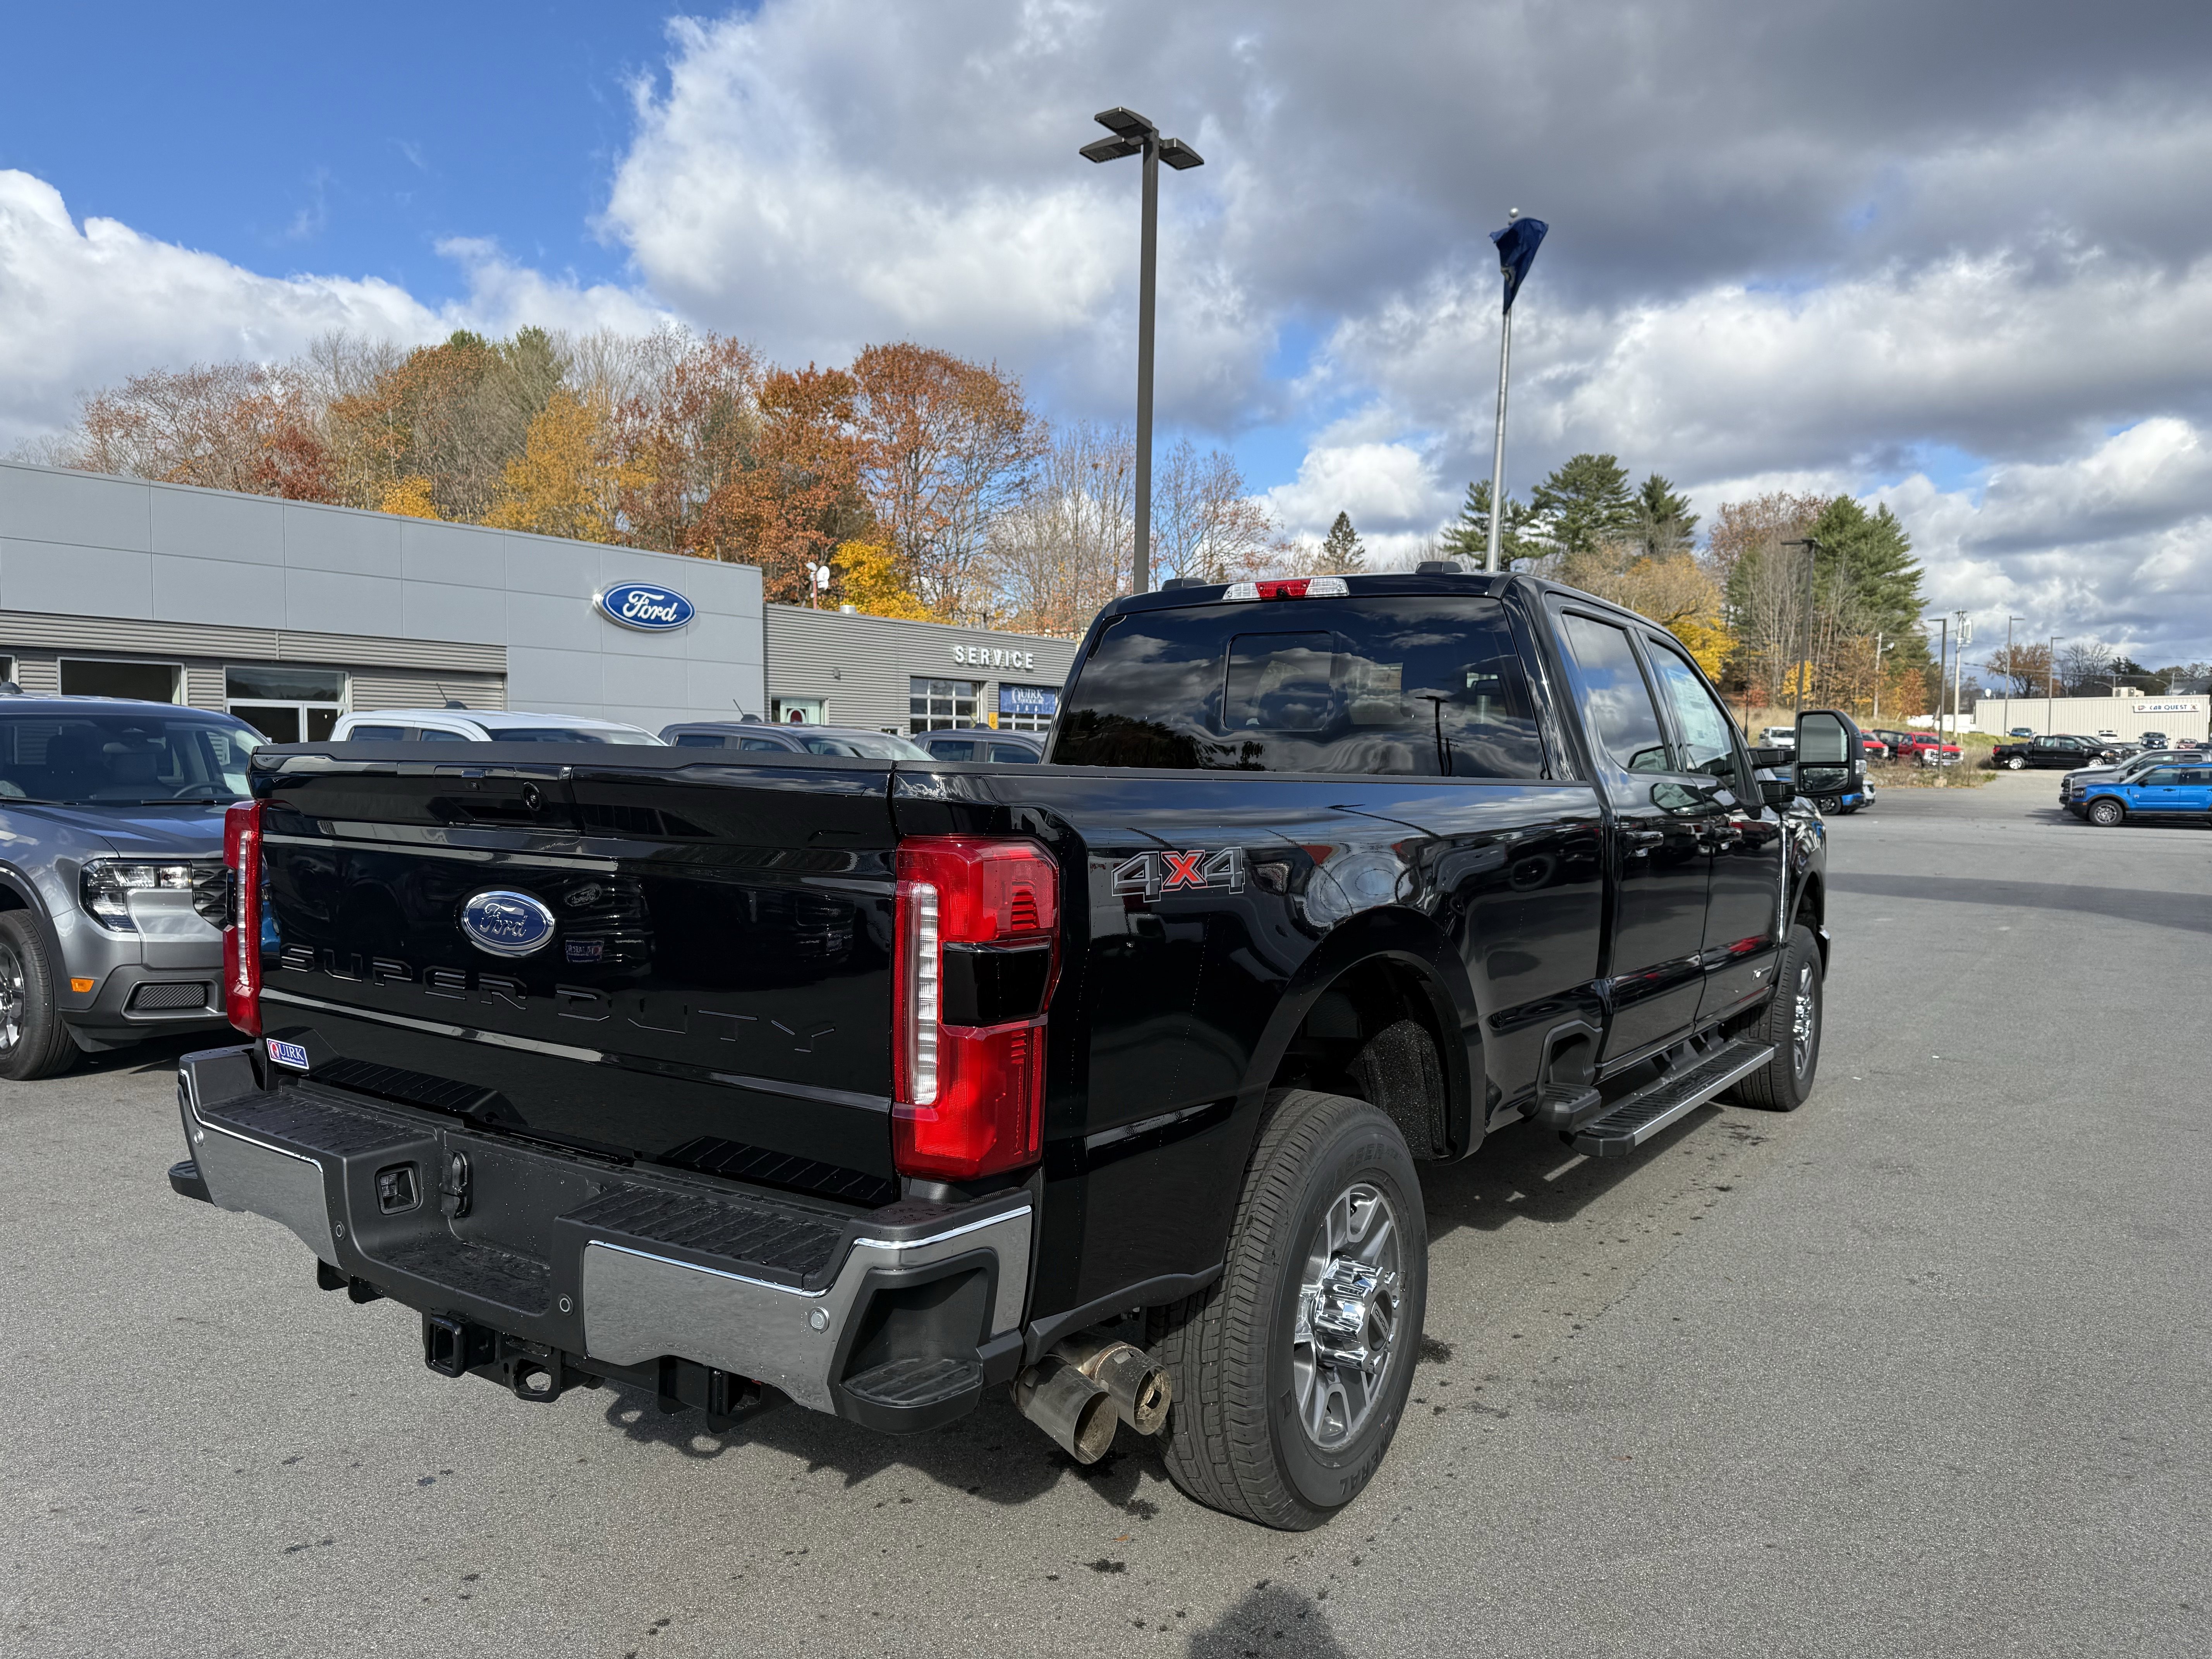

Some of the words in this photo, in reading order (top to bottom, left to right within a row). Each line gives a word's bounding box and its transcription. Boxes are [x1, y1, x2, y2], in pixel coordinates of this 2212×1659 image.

[623, 591, 678, 622] Ford
[955, 646, 1033, 668] SERVICE
[1012, 687, 1044, 703] QUIRK
[480, 903, 528, 937] Ford
[281, 942, 527, 1010] SUPER
[554, 984, 836, 1053] DUTY
[270, 1042, 305, 1060] QUIRK
[1340, 1396, 1403, 1495] GENERAL
